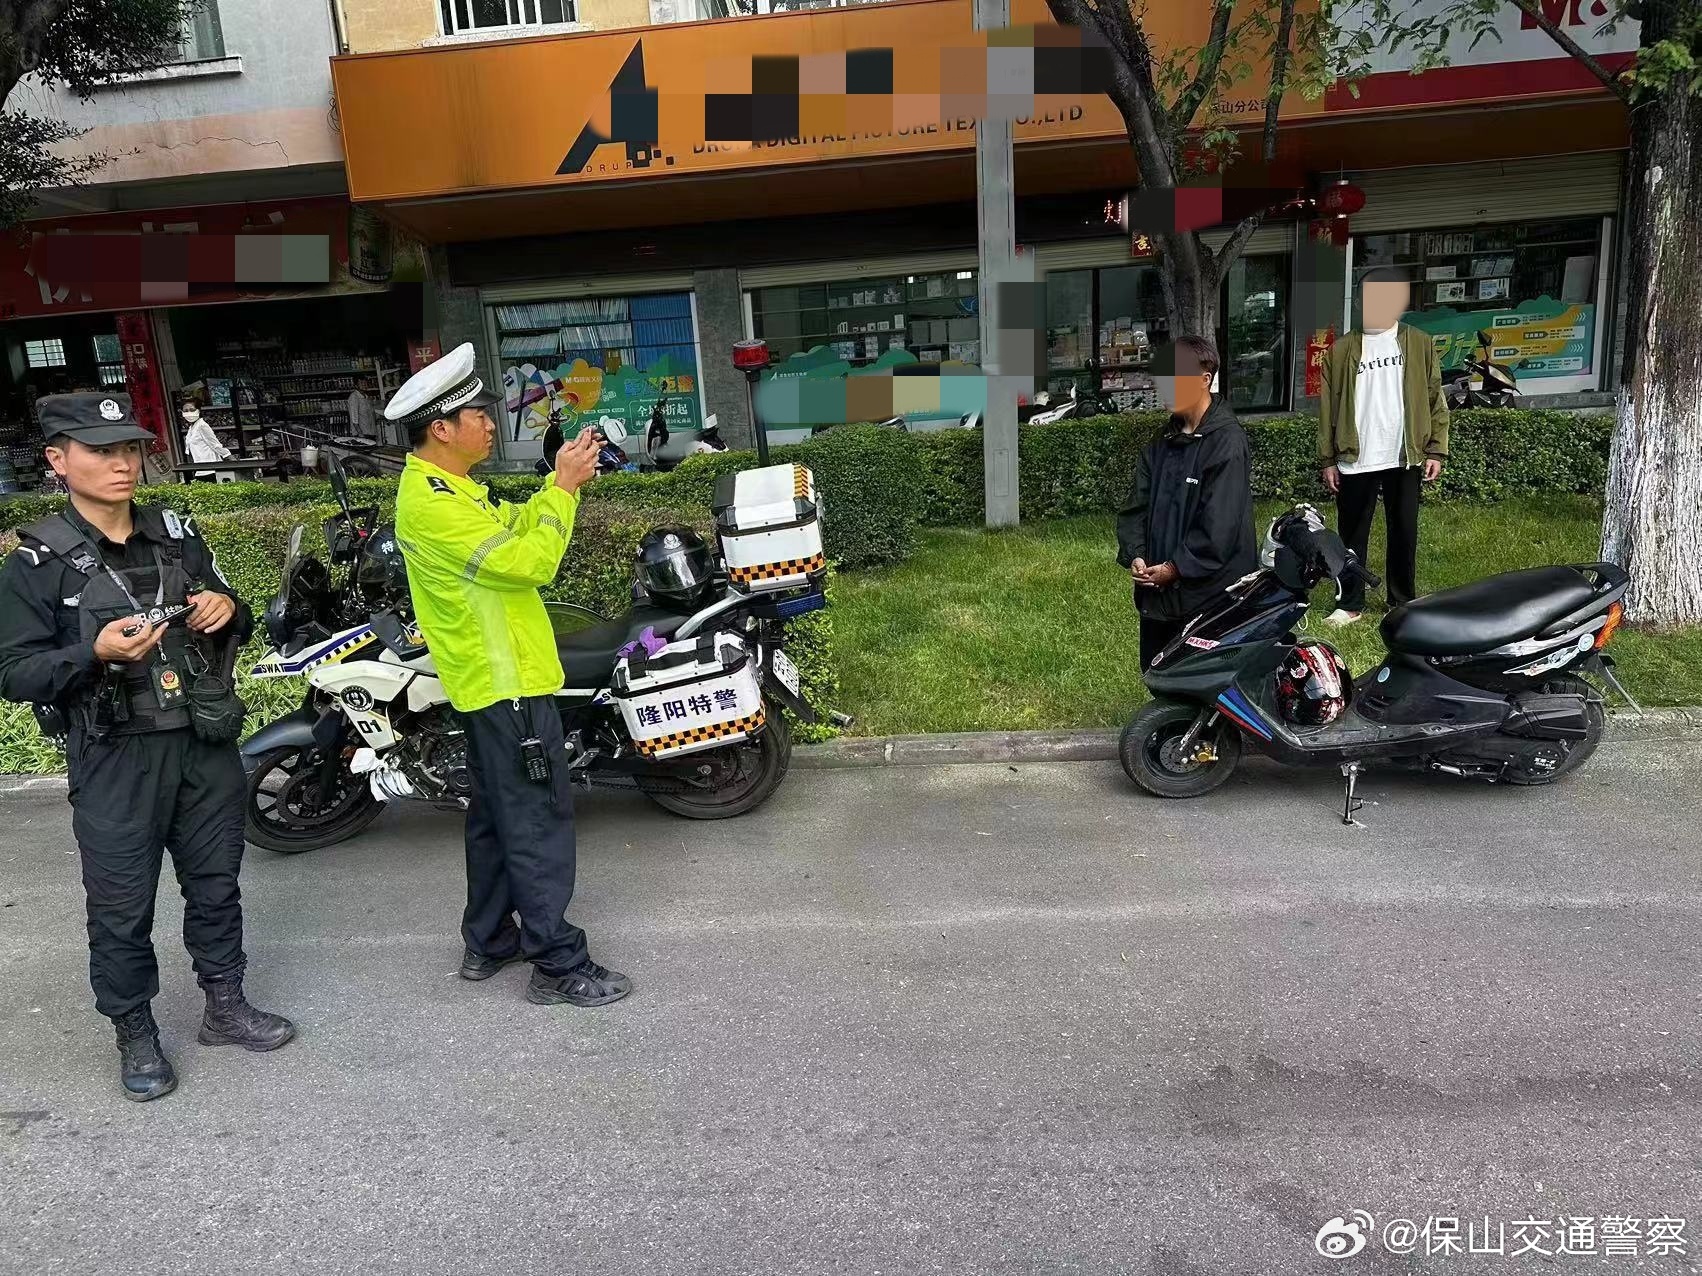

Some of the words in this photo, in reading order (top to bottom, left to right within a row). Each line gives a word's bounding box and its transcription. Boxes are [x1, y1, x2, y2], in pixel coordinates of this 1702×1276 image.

[381, 540, 395, 555] 特
[261, 663, 286, 674] SWAT
[635, 688, 739, 727] 隆阳特警
